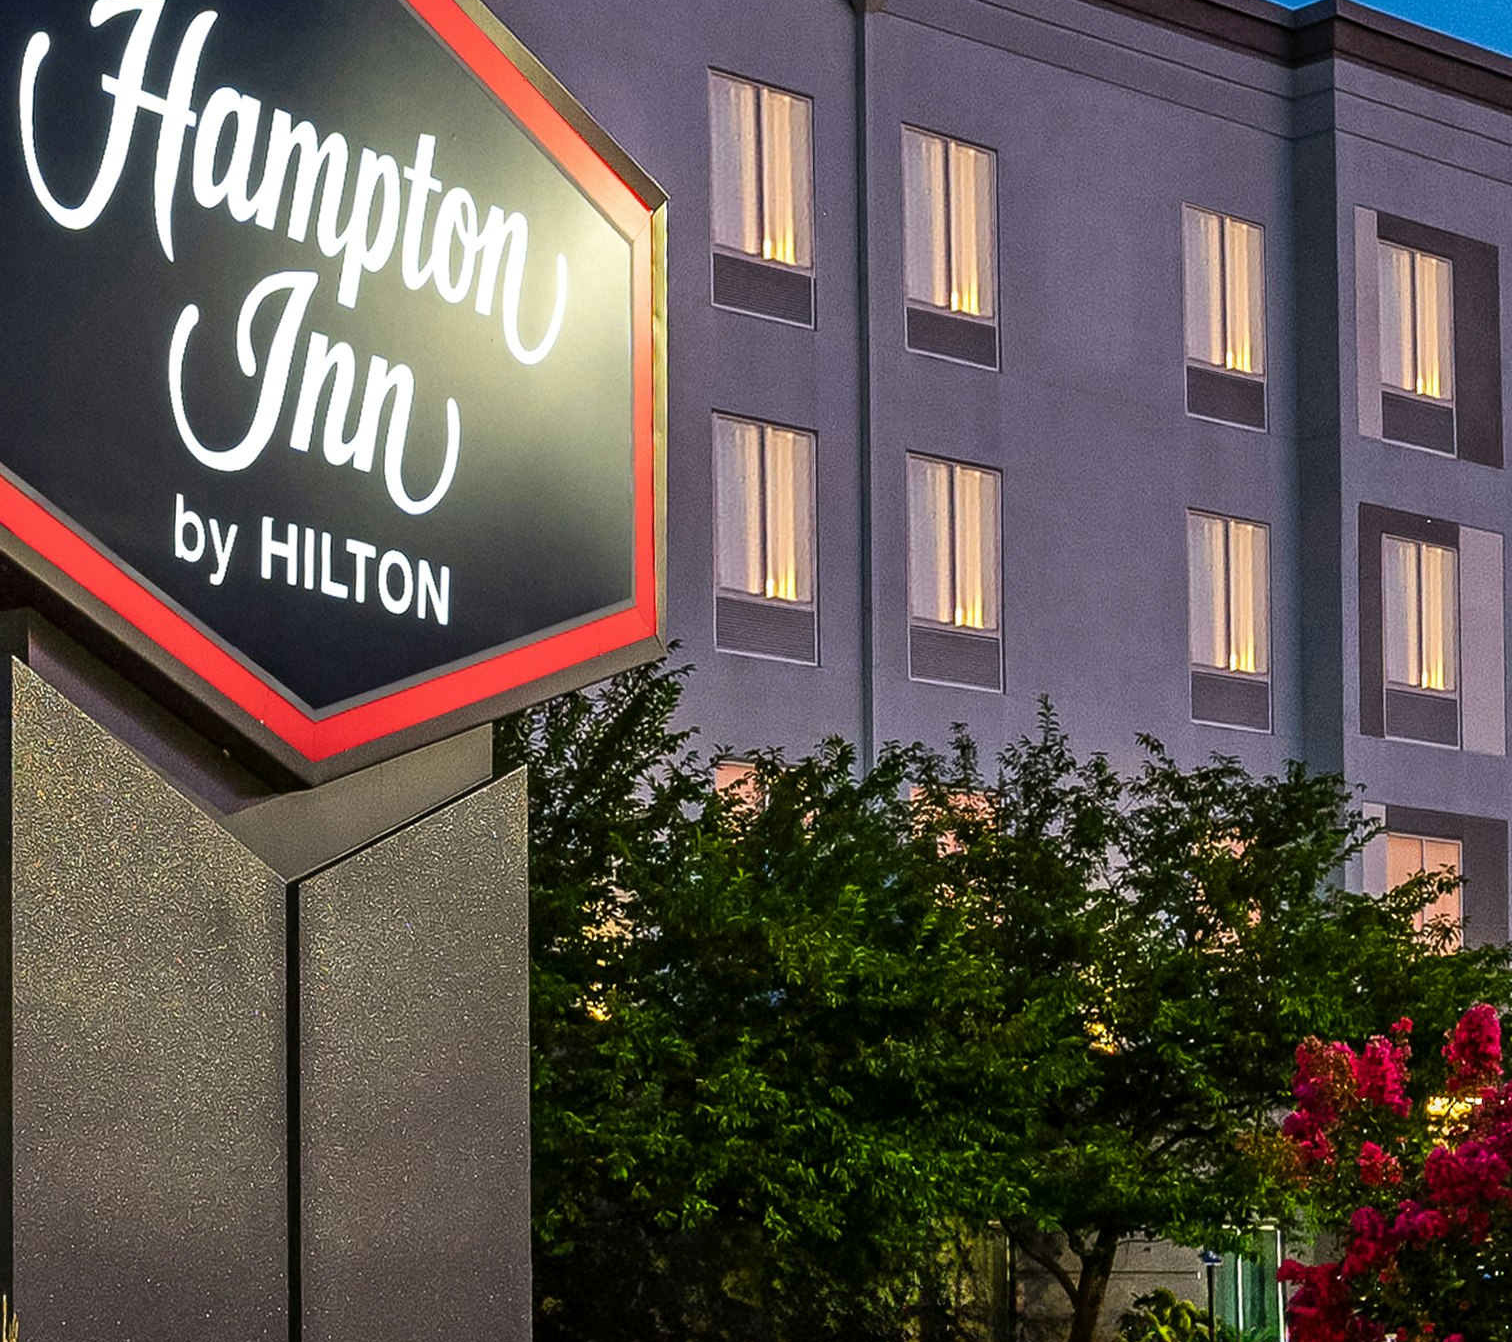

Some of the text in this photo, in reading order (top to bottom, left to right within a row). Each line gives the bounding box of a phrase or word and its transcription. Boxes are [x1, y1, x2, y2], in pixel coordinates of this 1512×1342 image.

[168, 271, 461, 516] Inn
[174, 493, 451, 626] by HILTON
